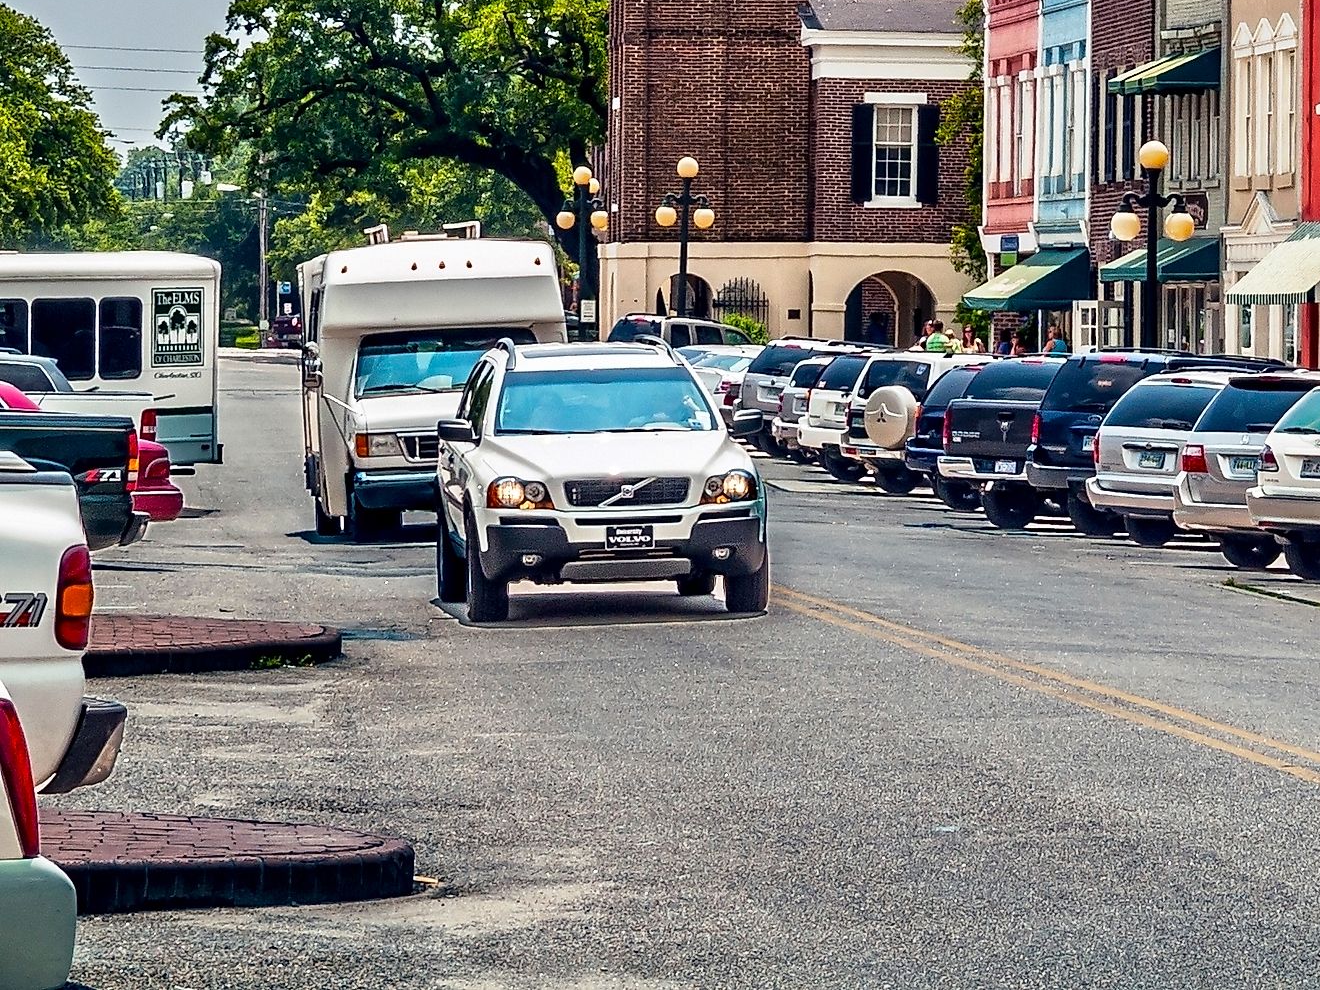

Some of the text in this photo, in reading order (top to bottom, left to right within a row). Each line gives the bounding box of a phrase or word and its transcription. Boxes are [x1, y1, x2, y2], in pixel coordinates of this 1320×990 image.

[156, 291, 200, 306] The ELMS
[85, 468, 122, 482] Z71
[609, 535, 651, 543] VOLVO
[0, 592, 49, 628] 71
